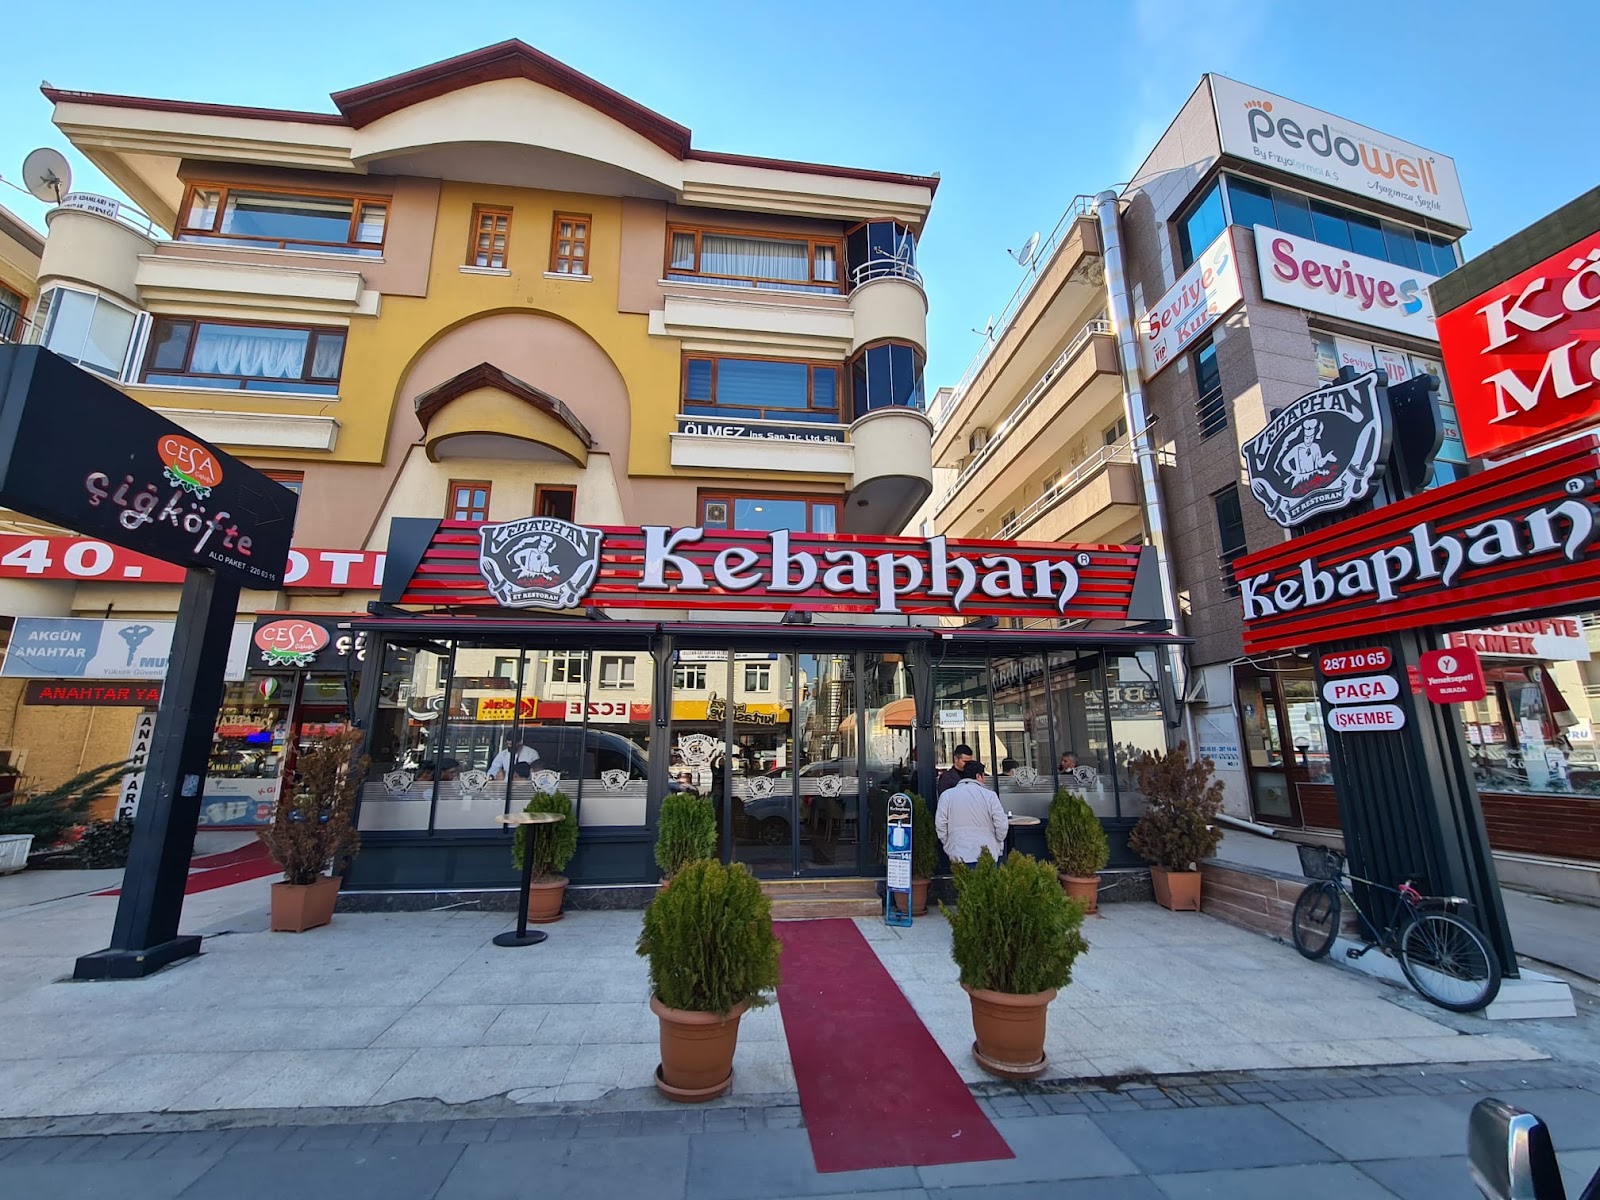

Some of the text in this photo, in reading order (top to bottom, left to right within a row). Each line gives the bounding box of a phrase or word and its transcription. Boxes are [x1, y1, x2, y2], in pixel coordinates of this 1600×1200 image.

[1248, 108, 1438, 196] pedowell
[1253, 146, 1267, 160] By
[1272, 238, 1398, 310] Seviye
[1149, 267, 1215, 341] Seviye
[1177, 302, 1218, 345] Kurs
[1342, 353, 1374, 370] Seviye
[1385, 362, 1405, 382] VIP
[1481, 338, 1600, 425] M
[164, 439, 215, 481] CESA
[1291, 490, 1343, 516] ET RESTORAN
[481, 519, 599, 557] KEBAPHAN
[208, 550, 224, 562] ALO
[224, 556, 247, 570] PAKET
[637, 524, 1079, 613] Kebaphan
[1237, 500, 1593, 621] Kebaphan
[512, 591, 559, 601] ET RESTORAN
[28, 630, 82, 642] AKGÜN
[262, 624, 318, 650] CESA
[1450, 633, 1538, 655] EKMEK
[15, 646, 86, 658] ANAHTAR
[1323, 651, 1386, 671] 287 10 65
[1427, 673, 1474, 686] Yemeksepeti
[39, 687, 130, 700] ANAHTAR
[1335, 681, 1387, 699] PAÇA
[1439, 686, 1467, 695] BURADA
[1335, 711, 1395, 728] İŞKEMBE
